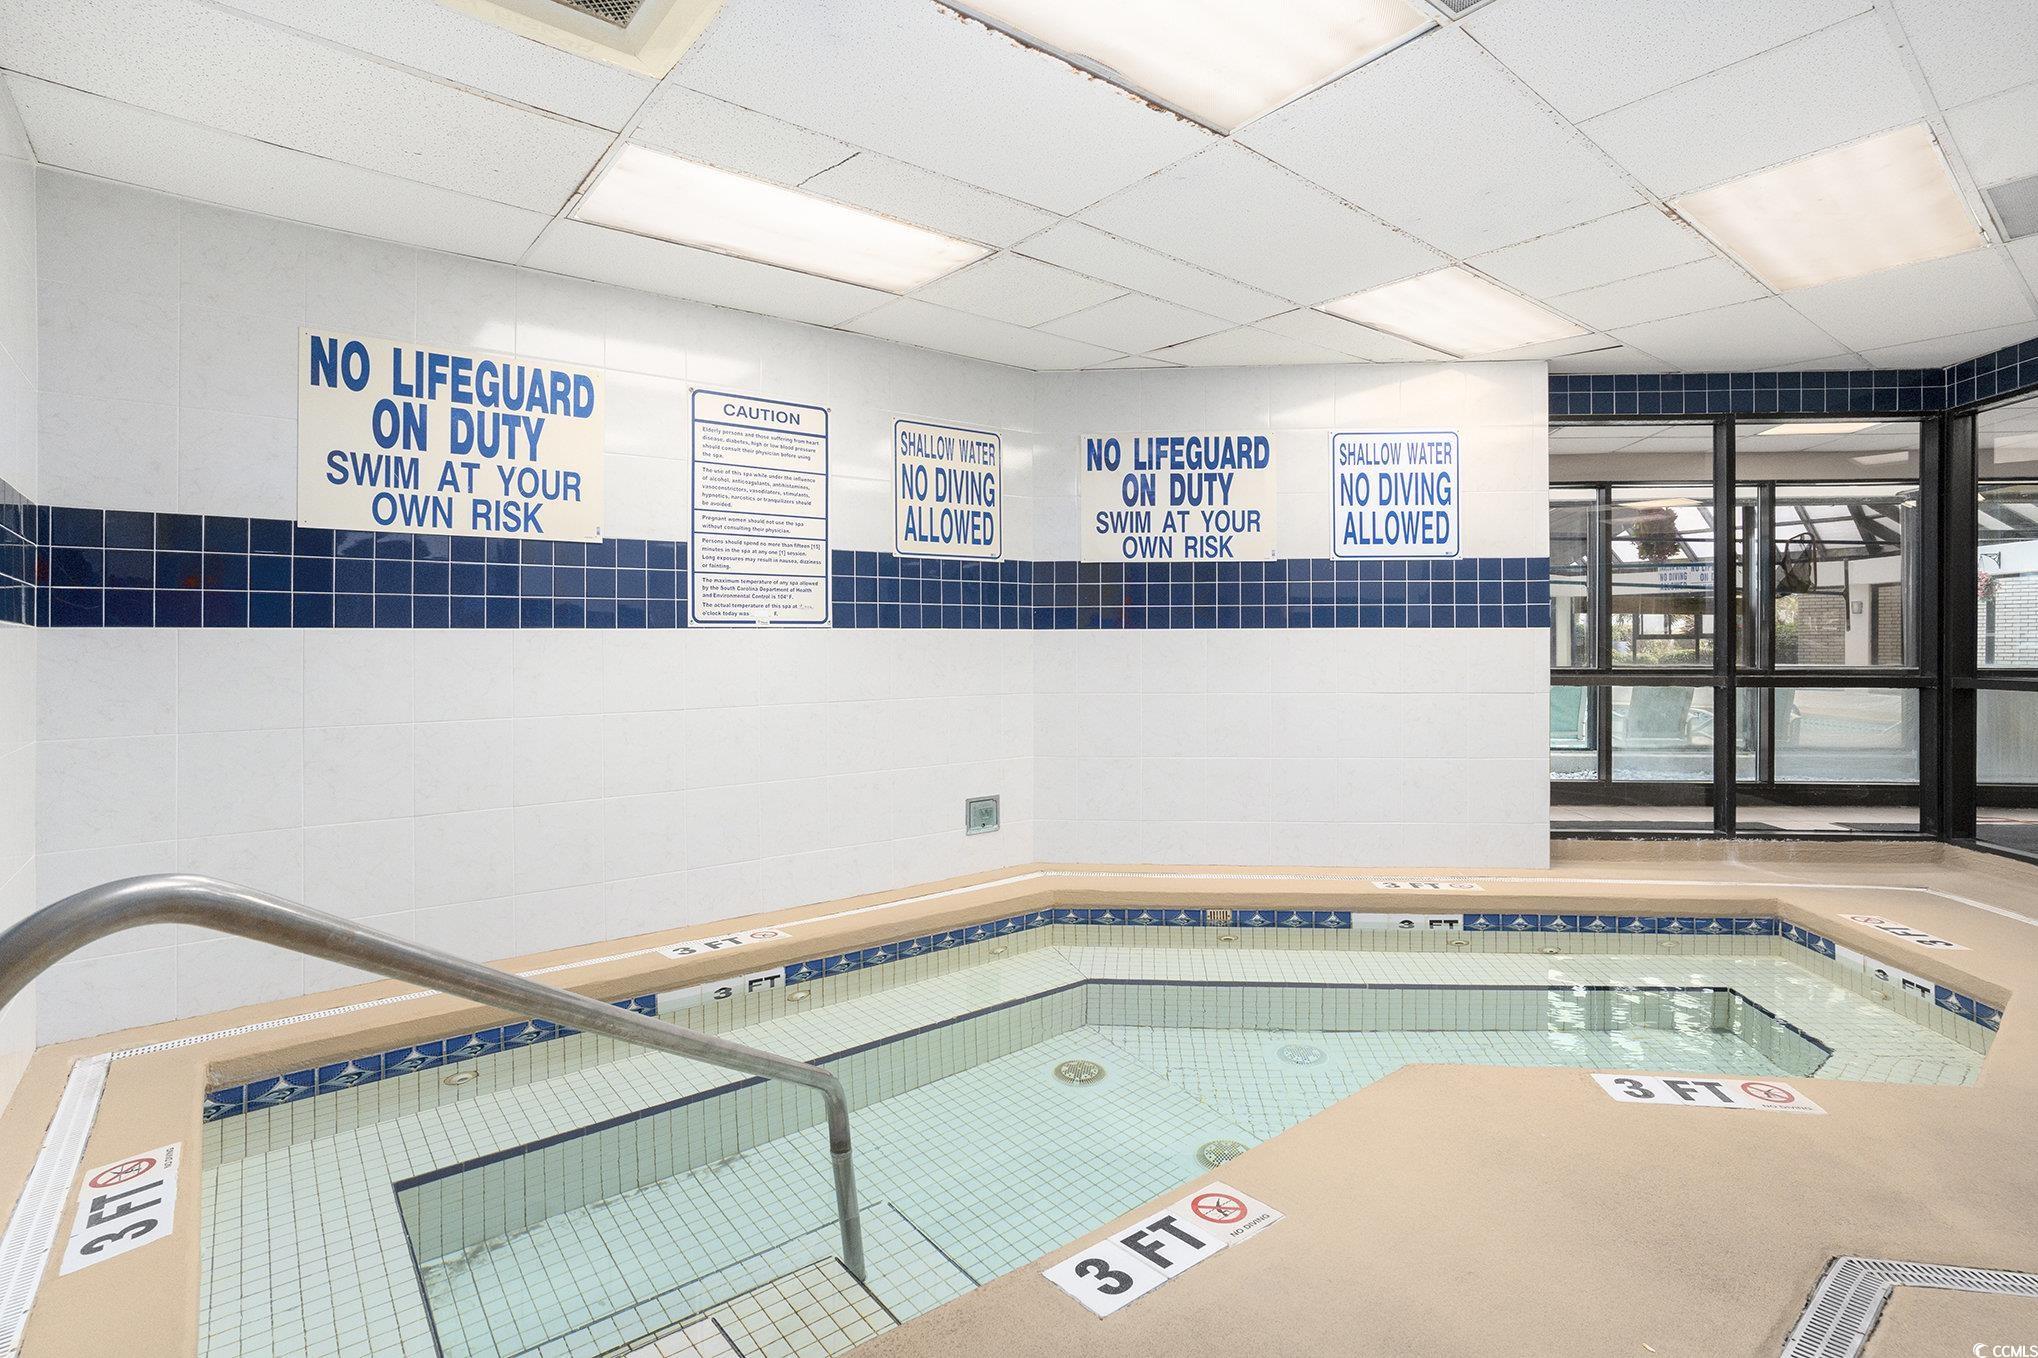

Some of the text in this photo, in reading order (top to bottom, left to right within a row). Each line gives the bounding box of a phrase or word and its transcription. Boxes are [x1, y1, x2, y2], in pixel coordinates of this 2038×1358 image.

[310, 336, 594, 418] NO LIFEGUARD
[372, 399, 545, 461] ON DUTY
[724, 404, 800, 425] CAUTION
[901, 431, 995, 466] SHALLOW WATER
[1087, 436, 1270, 471] NO LIFEGUARD
[1340, 442, 1452, 465] SHALLOW WATER
[326, 450, 581, 502] SWIM AT YOUR
[902, 464, 995, 507] NO DIVING
[1122, 473, 1234, 507] ON DUTY
[1341, 472, 1451, 506] NO DIVING
[372, 492, 544, 533] OWN RISK
[904, 506, 994, 545] ALLOWED
[1096, 510, 1261, 534] SWIM AT YOUR
[1343, 511, 1449, 545] ALLOWED
[1123, 536, 1233, 558] OWN RISK
[1429, 920, 1458, 929] FT
[673, 936, 742, 955] 3 FT
[714, 974, 780, 1000] 3 FT
[1902, 978, 1931, 998] FT
[1614, 1078, 1734, 1103] 3 FT
[80, 1179, 164, 1255] 3 FT
[1230, 1213, 1270, 1238] NO DIVING
[1074, 1215, 1206, 1295] 3 FT
